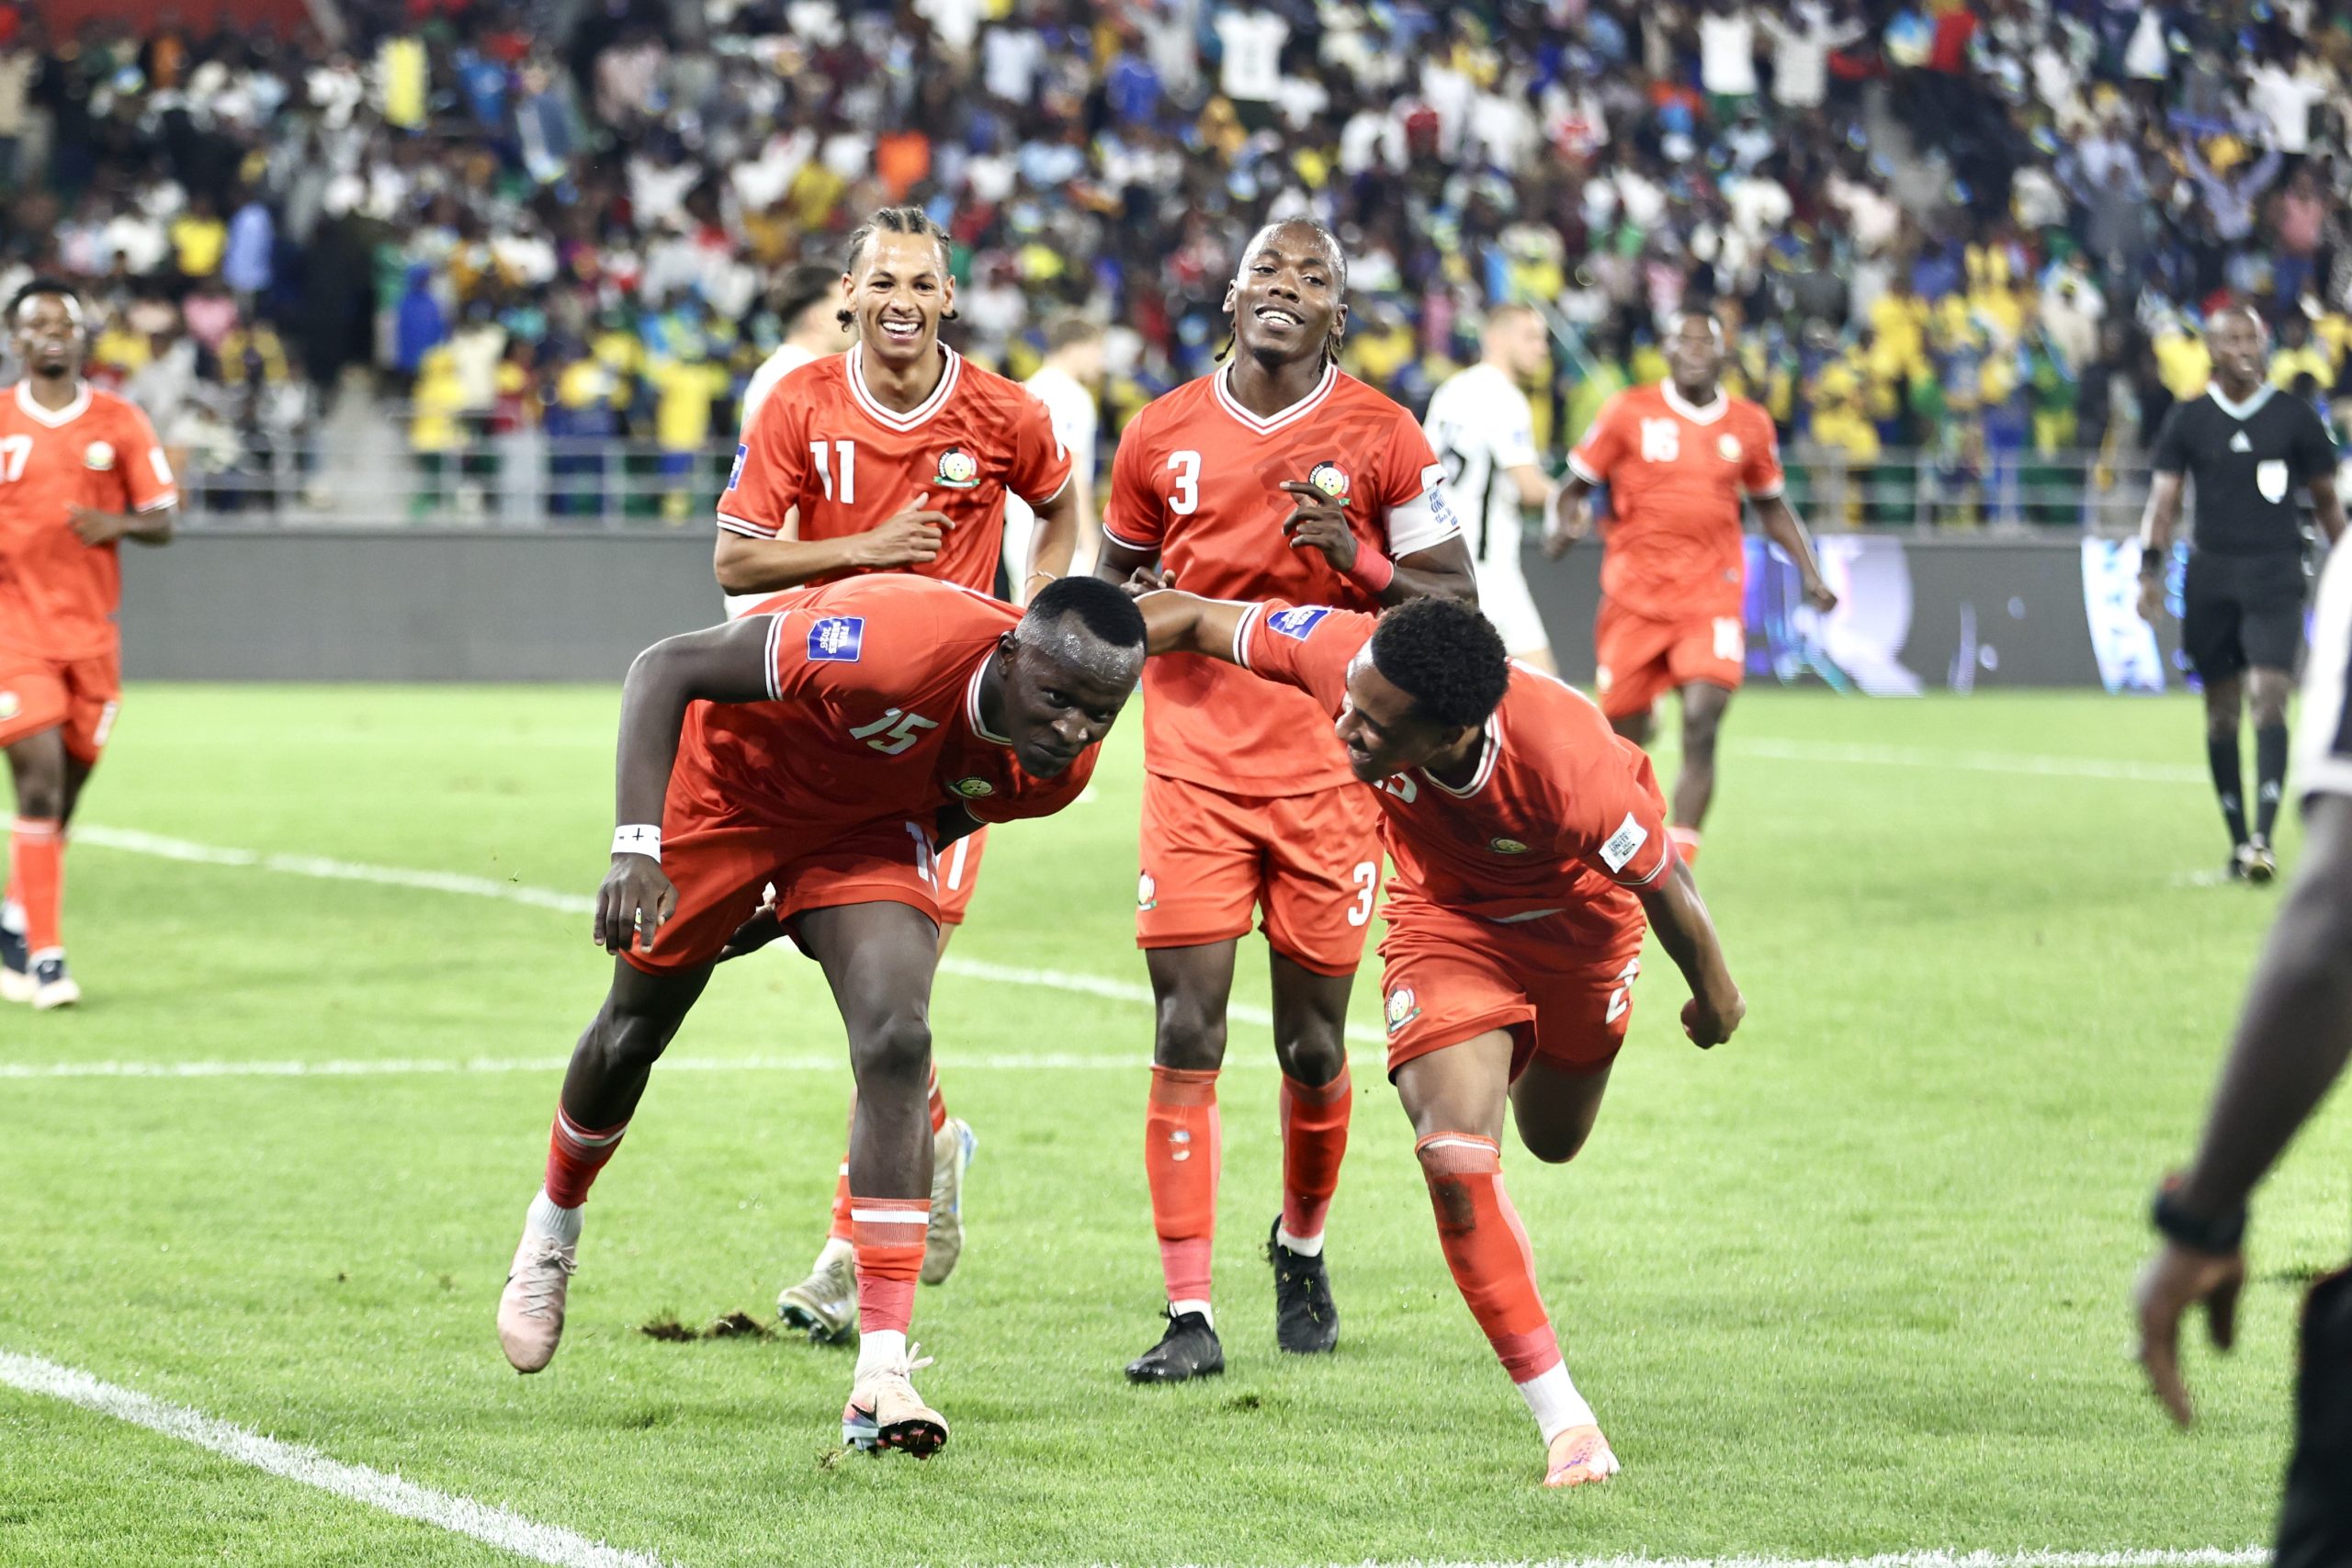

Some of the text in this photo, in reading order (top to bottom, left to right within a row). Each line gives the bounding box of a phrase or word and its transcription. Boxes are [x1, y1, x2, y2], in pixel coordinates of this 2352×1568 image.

[0, 434, 33, 485] 7
[1639, 416, 1680, 464] 16
[809, 440, 854, 504] 11
[1167, 450, 1202, 515] 3
[837, 626, 850, 649] FIFA
[849, 707, 939, 754] 15
[1347, 861, 1377, 927] 3
